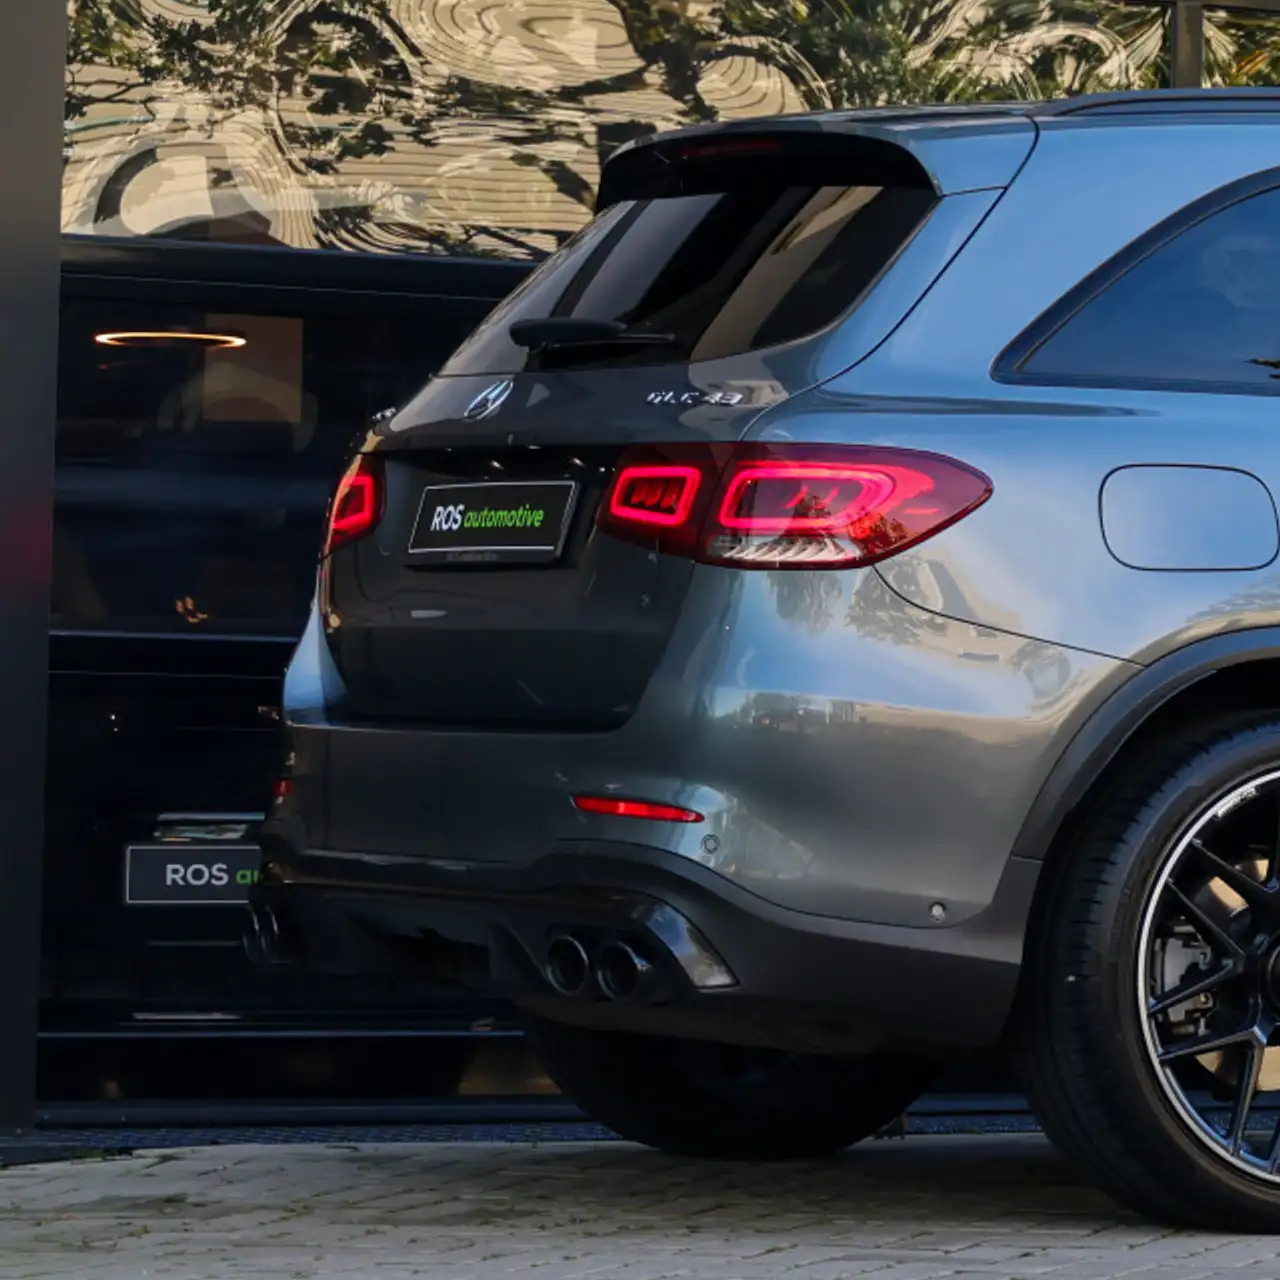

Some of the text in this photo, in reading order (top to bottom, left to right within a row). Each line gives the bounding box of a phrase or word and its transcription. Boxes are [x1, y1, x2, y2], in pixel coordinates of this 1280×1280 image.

[430, 504, 544, 531] ROS automotive
[165, 863, 229, 886] ROS
